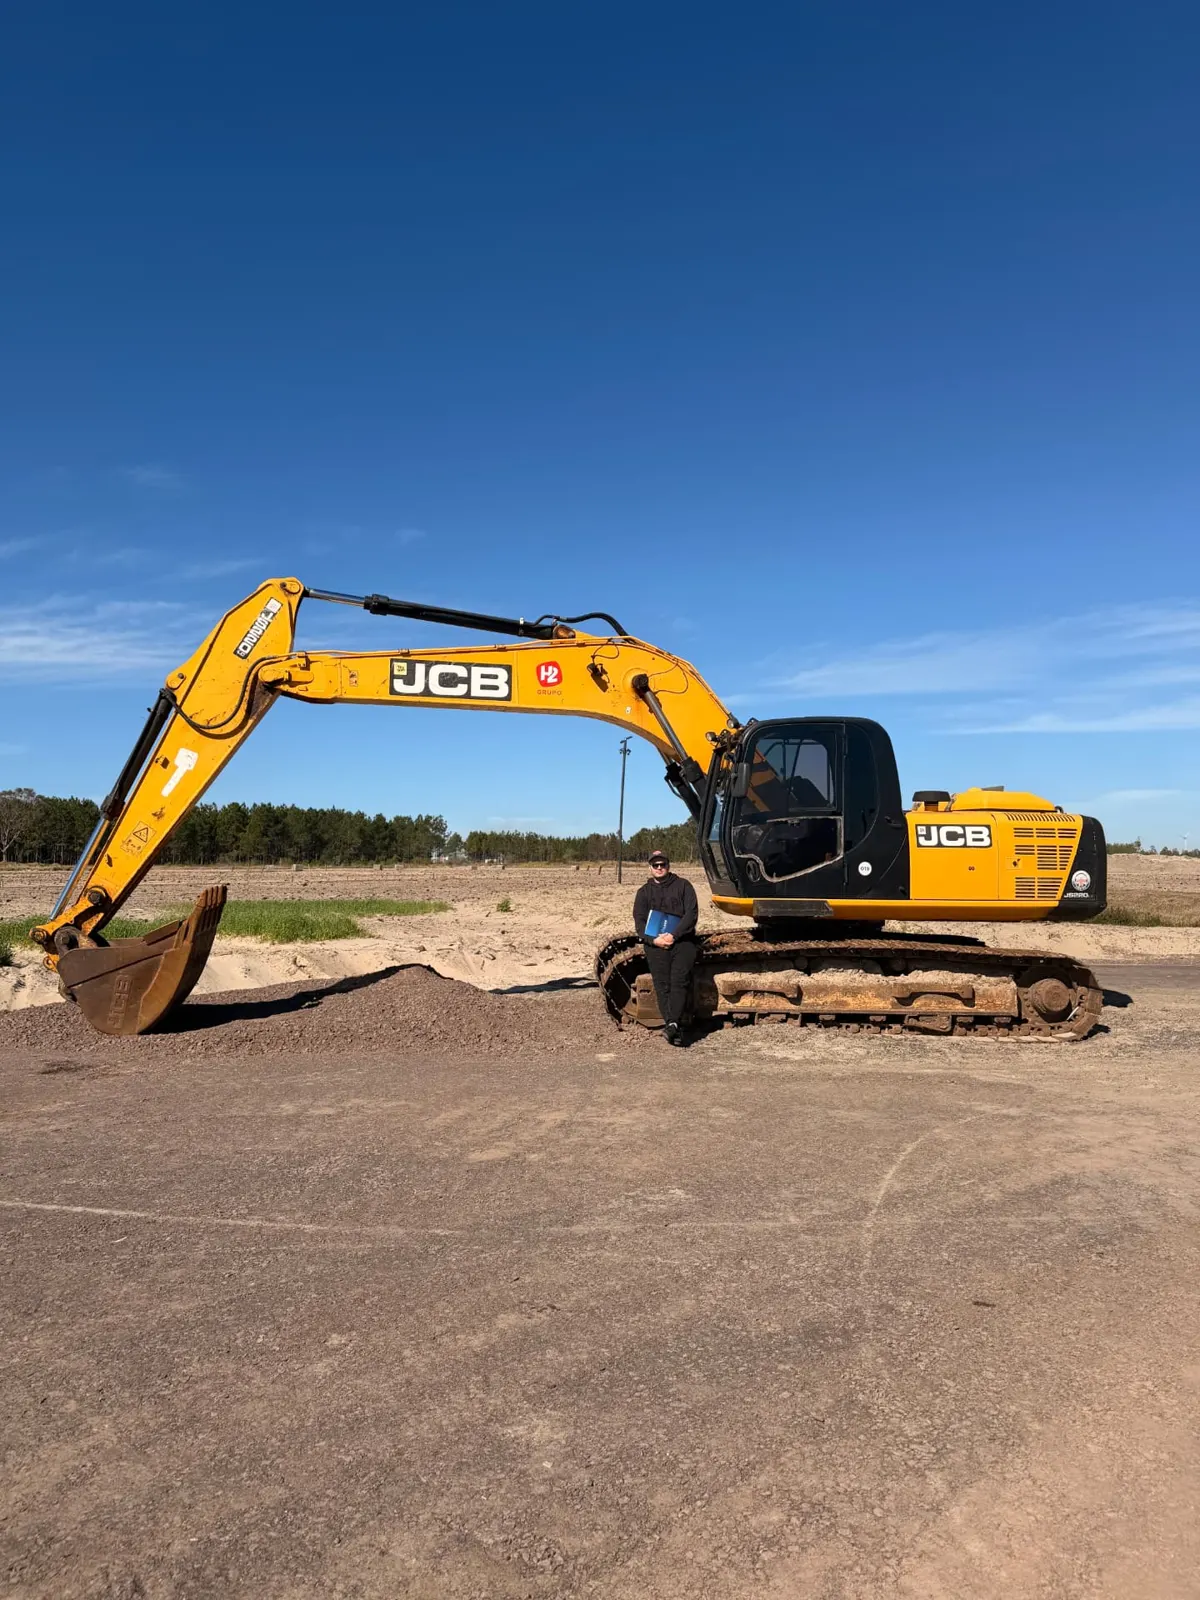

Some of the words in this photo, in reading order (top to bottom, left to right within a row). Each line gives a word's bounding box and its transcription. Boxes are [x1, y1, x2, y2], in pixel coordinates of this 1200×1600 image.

[393, 663, 509, 698] JCB
[540, 665, 559, 683] H2
[918, 826, 991, 847] JCB
[106, 970, 129, 1028] JCB
